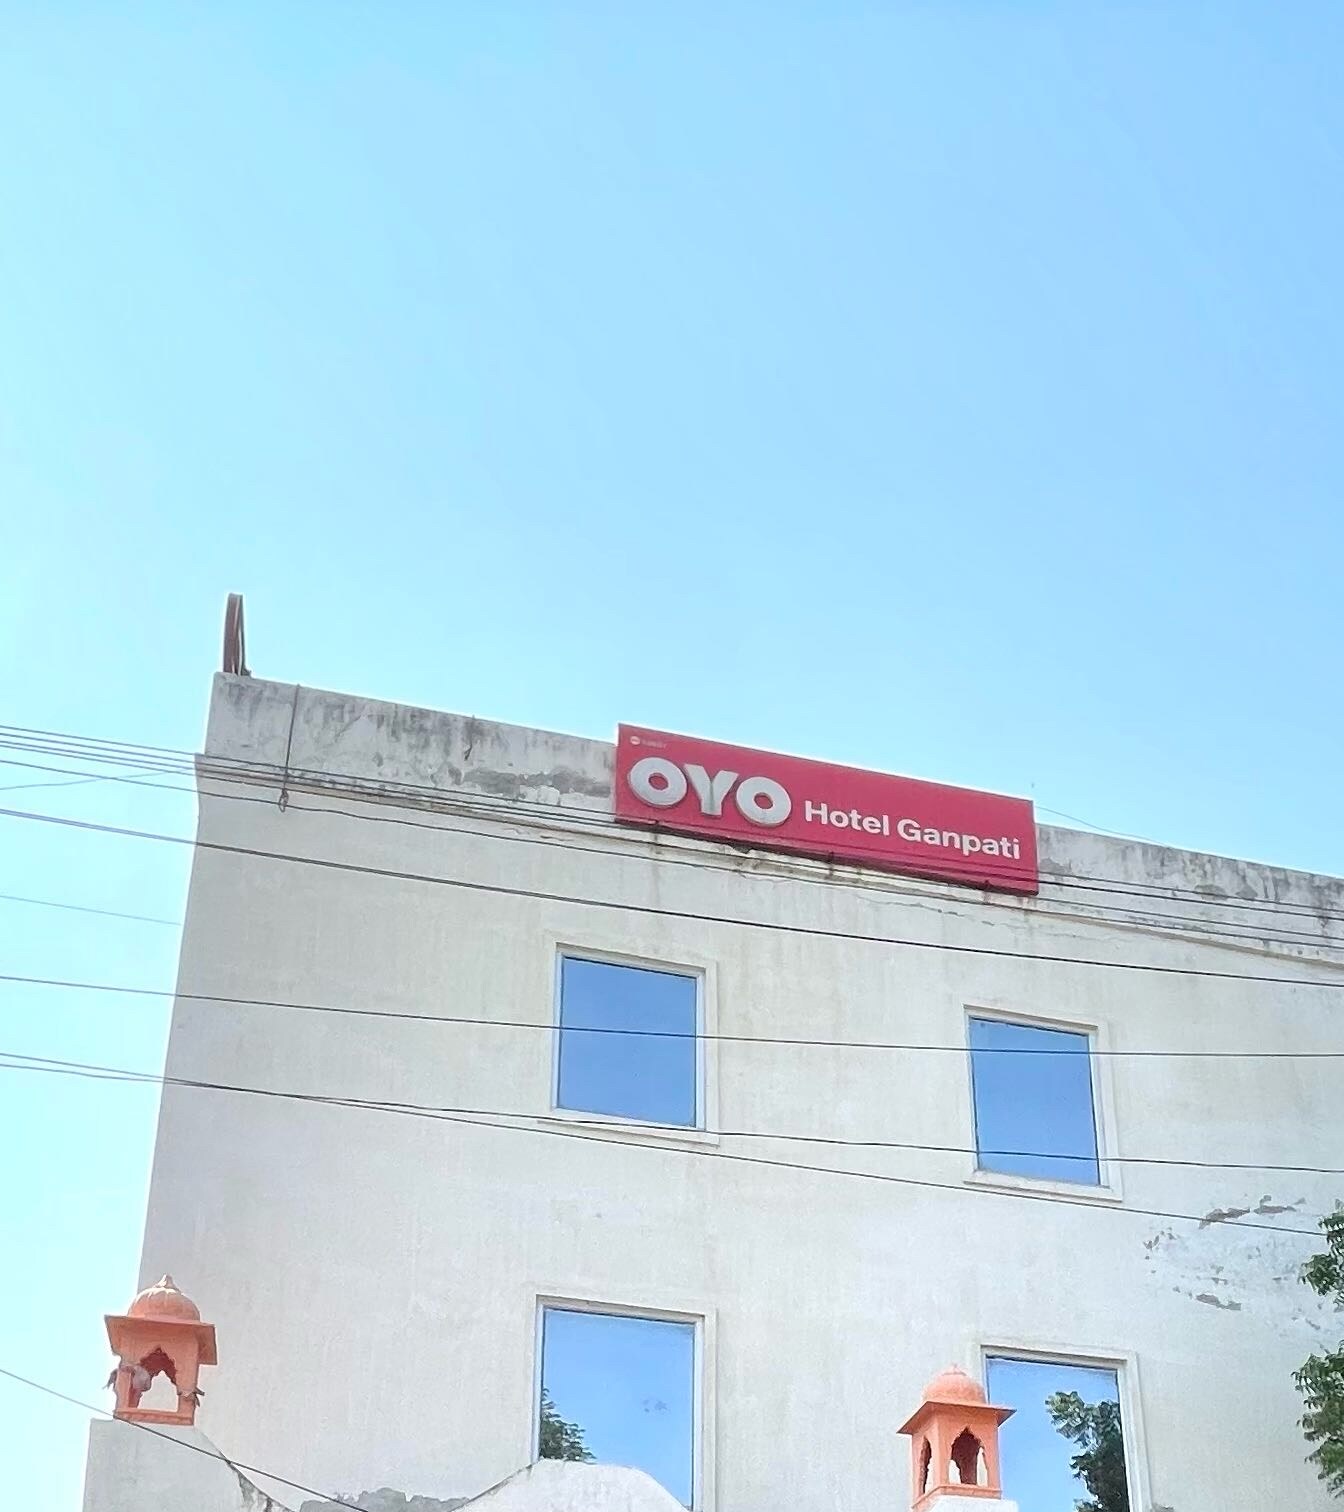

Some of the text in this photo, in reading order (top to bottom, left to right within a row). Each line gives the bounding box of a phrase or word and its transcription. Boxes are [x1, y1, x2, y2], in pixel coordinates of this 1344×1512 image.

[628, 757, 1020, 860] OYO Hotel Ganpati
